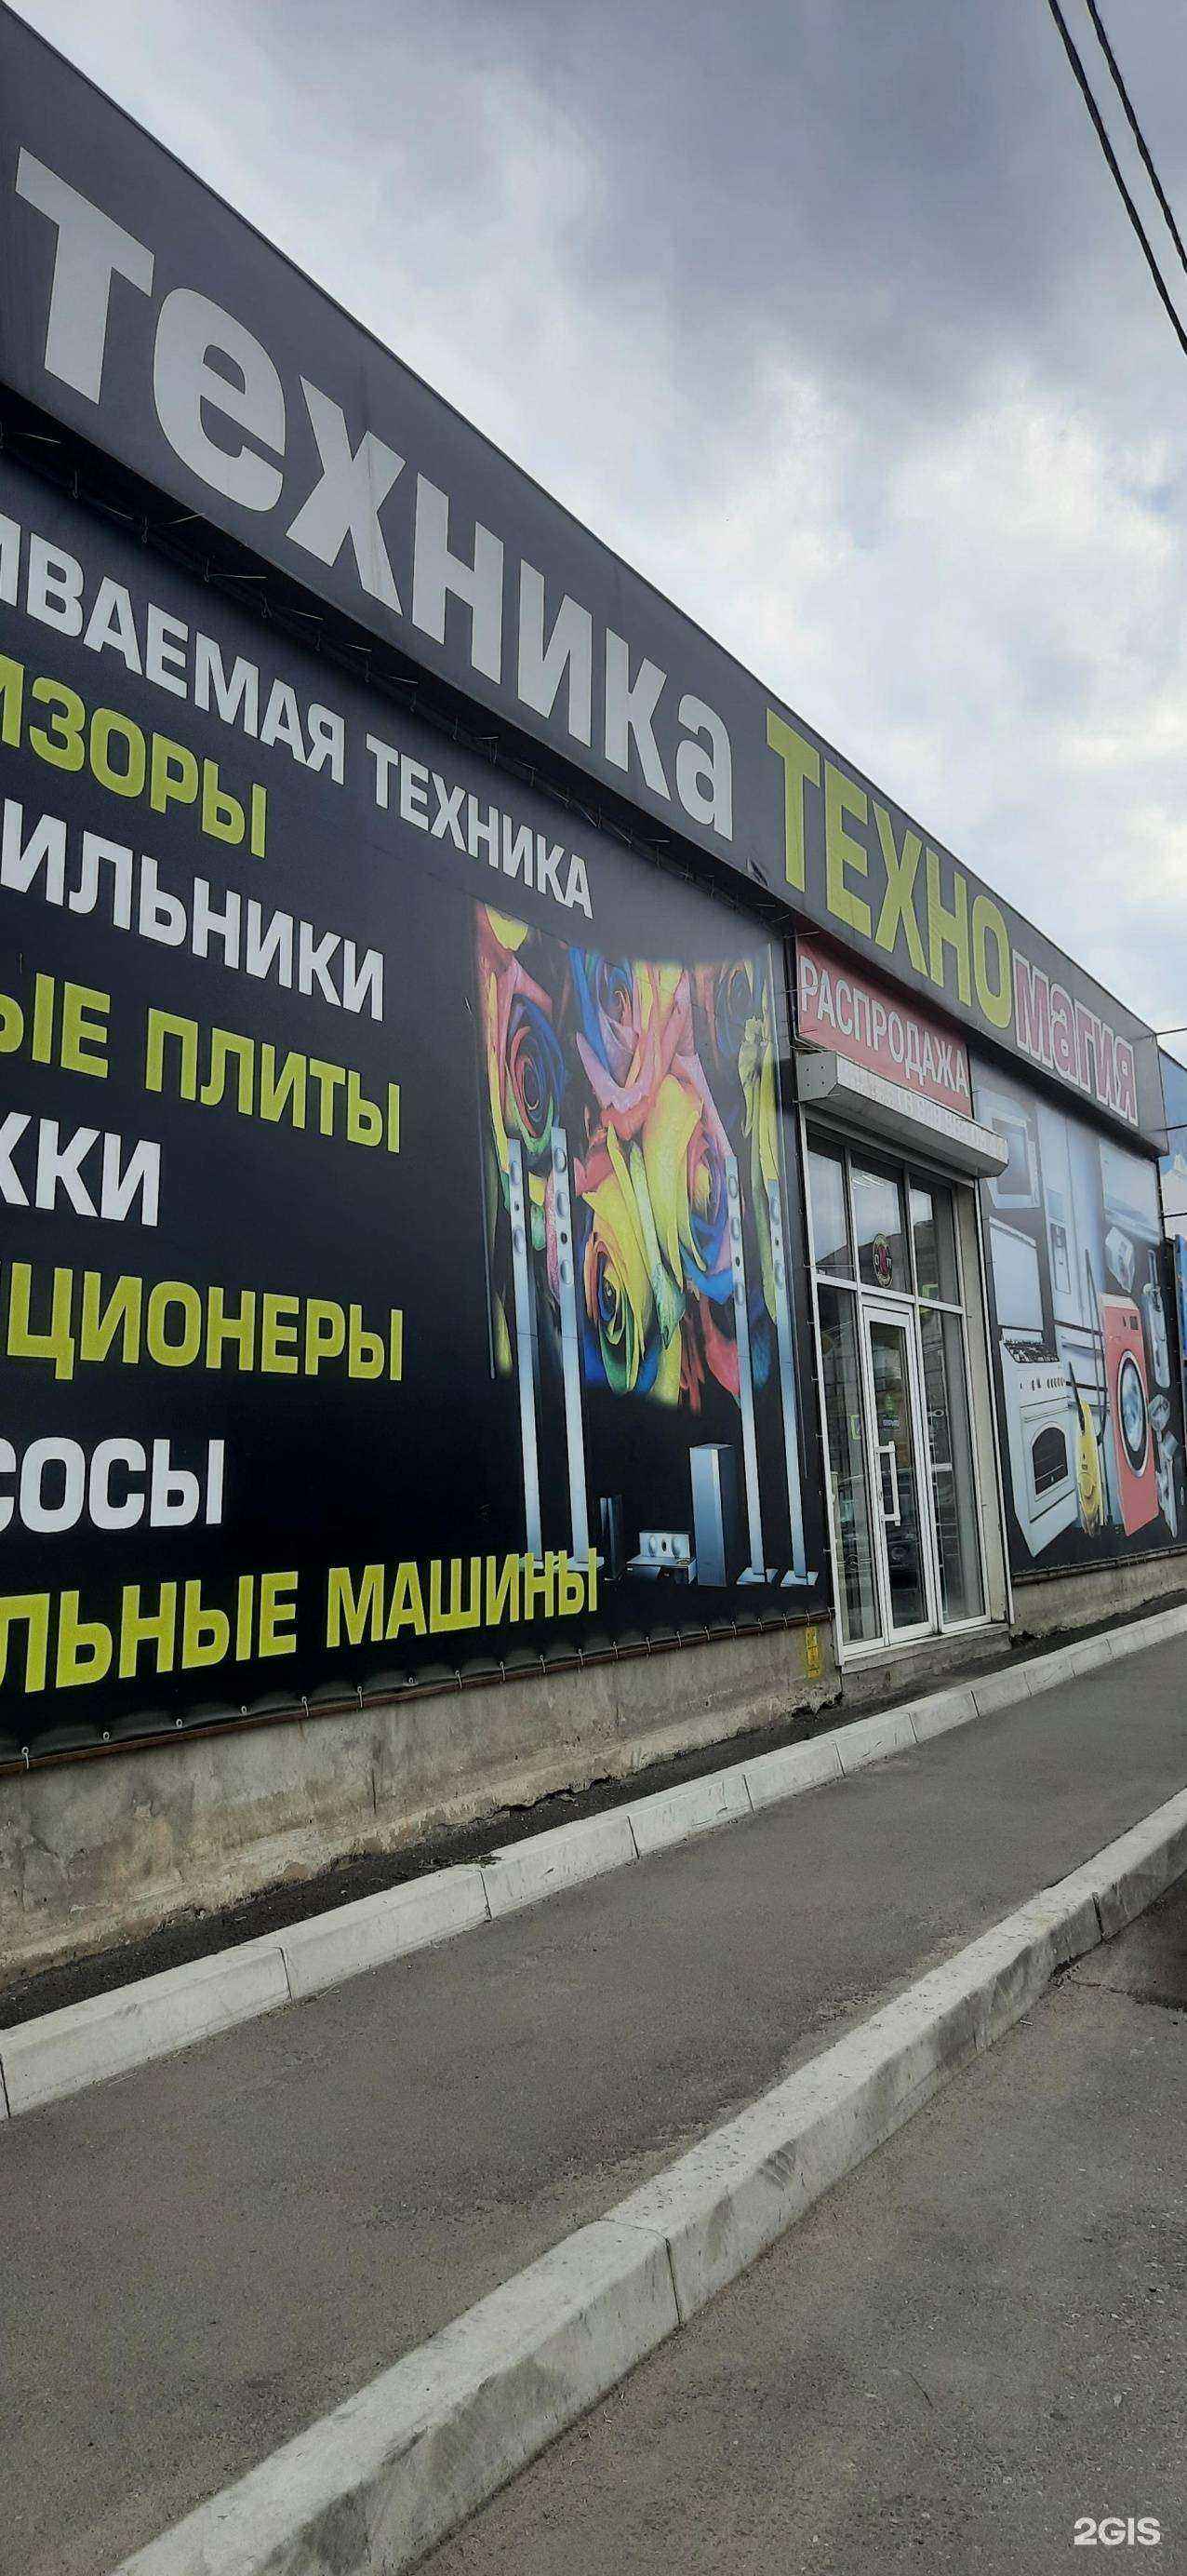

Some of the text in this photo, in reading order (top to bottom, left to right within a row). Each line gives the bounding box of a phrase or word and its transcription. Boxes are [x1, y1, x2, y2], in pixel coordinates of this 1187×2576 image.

[366, 733, 593, 919] ТЕХНИКА
[0, 798, 384, 1021] ИЛЬНИКИ
[145, 1009, 400, 1154] ПЛИТЫ
[800, 954, 970, 1098] РАСПРОДАЖА
[6, 1262, 403, 1381] ЦИОНЕРЫ
[0, 1437, 224, 1534] ОСЫ
[0, 1547, 598, 1693] ЛЬНЫЕ МАШИНЫ
